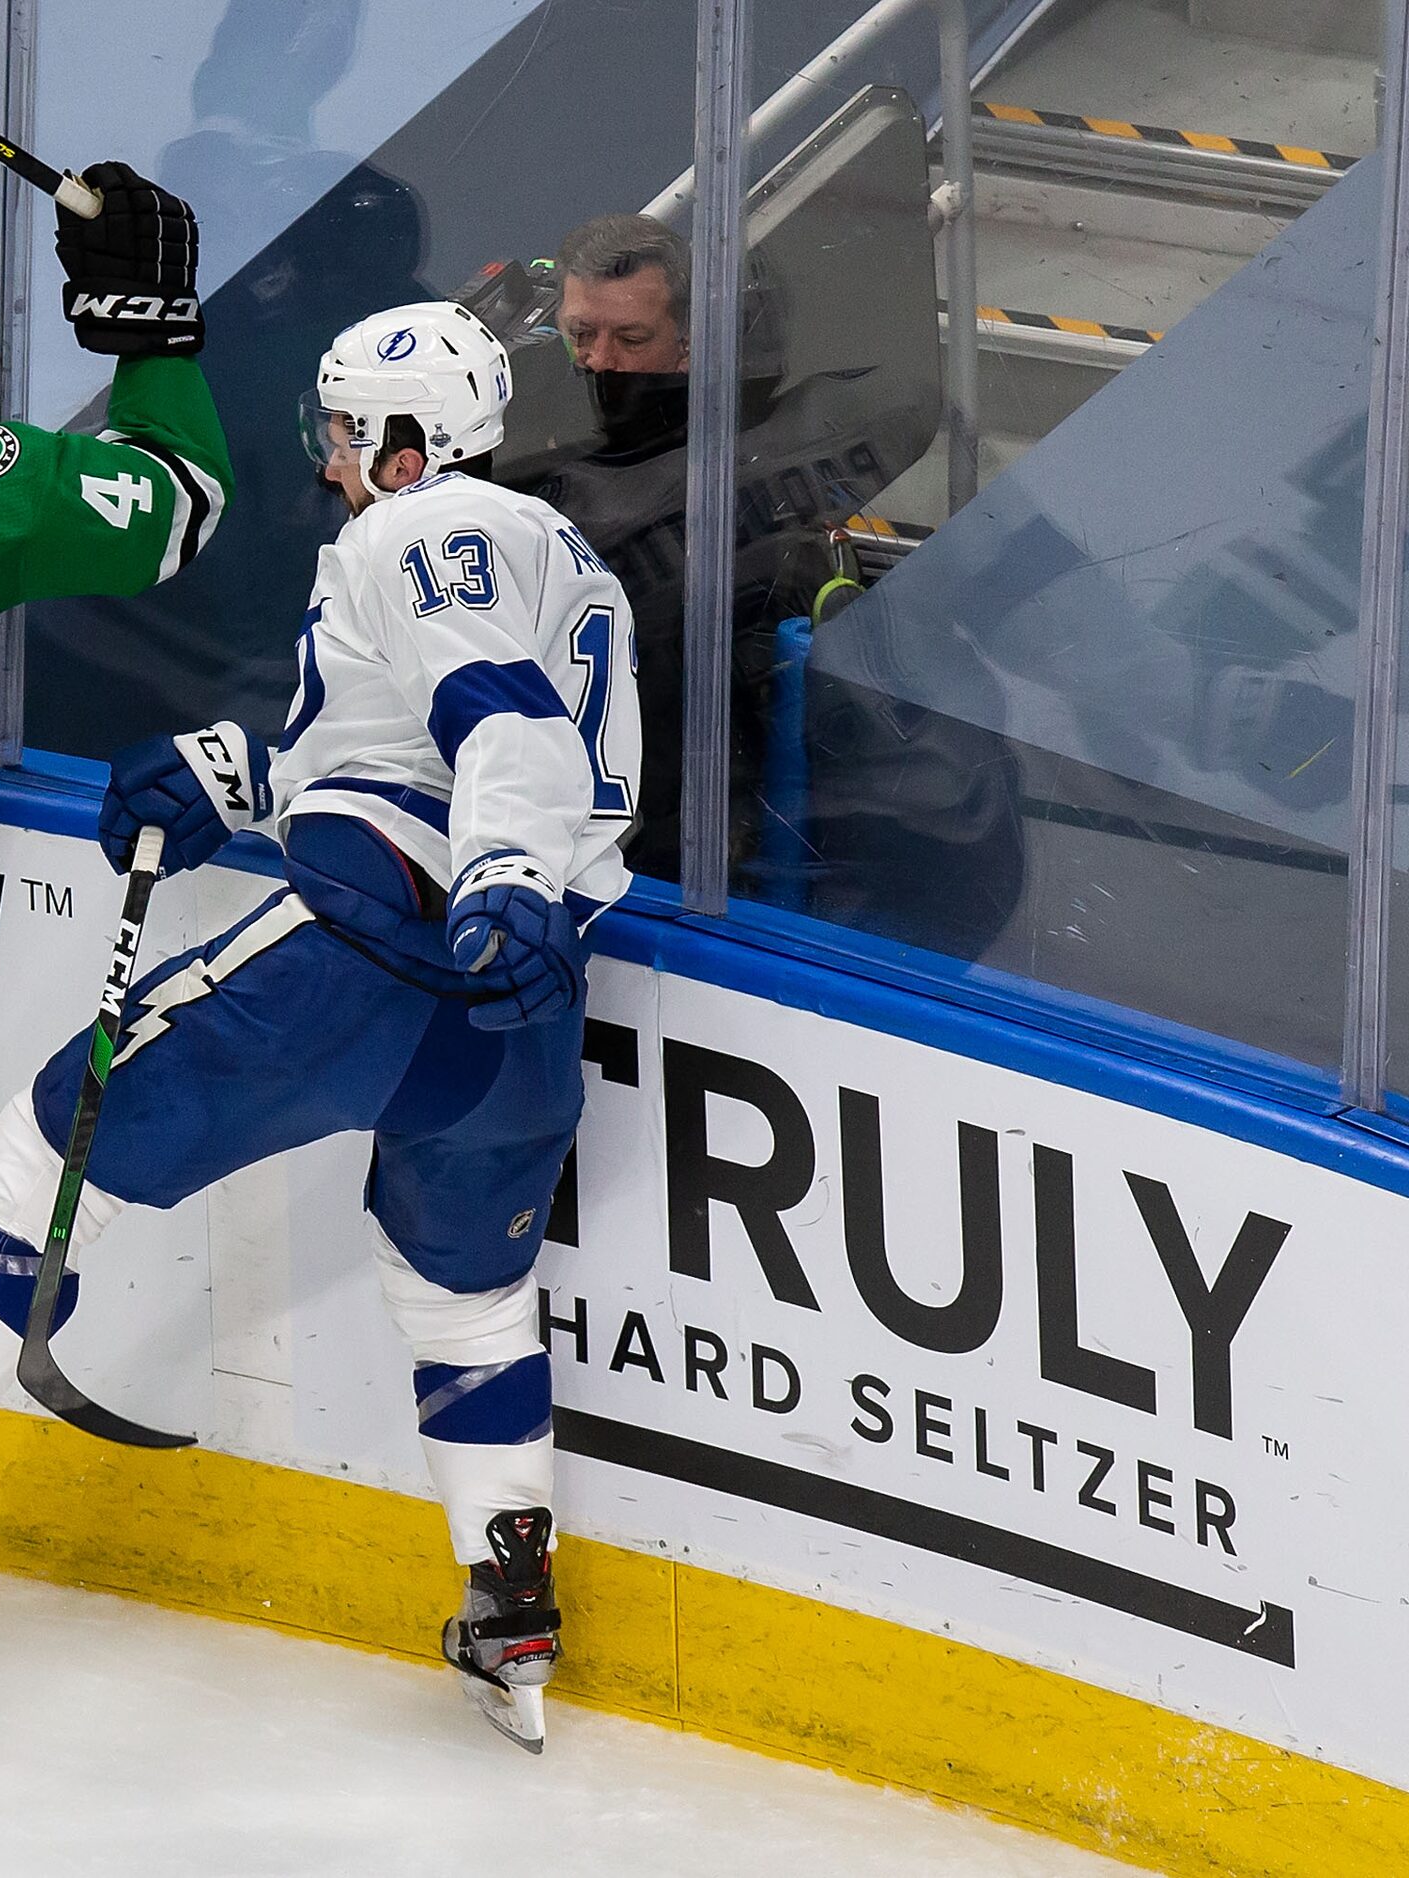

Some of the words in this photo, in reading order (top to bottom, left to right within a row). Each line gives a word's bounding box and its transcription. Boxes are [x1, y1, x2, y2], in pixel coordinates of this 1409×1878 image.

[70, 293, 199, 322] CCM
[79, 471, 153, 530] 4
[400, 528, 500, 619] 13
[569, 603, 638, 820] 1
[197, 728, 250, 812] CM
[21, 878, 73, 917] TM
[471, 863, 557, 893] CC
[99, 917, 141, 1018] CCM
[540, 1288, 801, 1415] HARD
[850, 1373, 1238, 1557] SELTZER
[1261, 1435, 1290, 1461] TM
